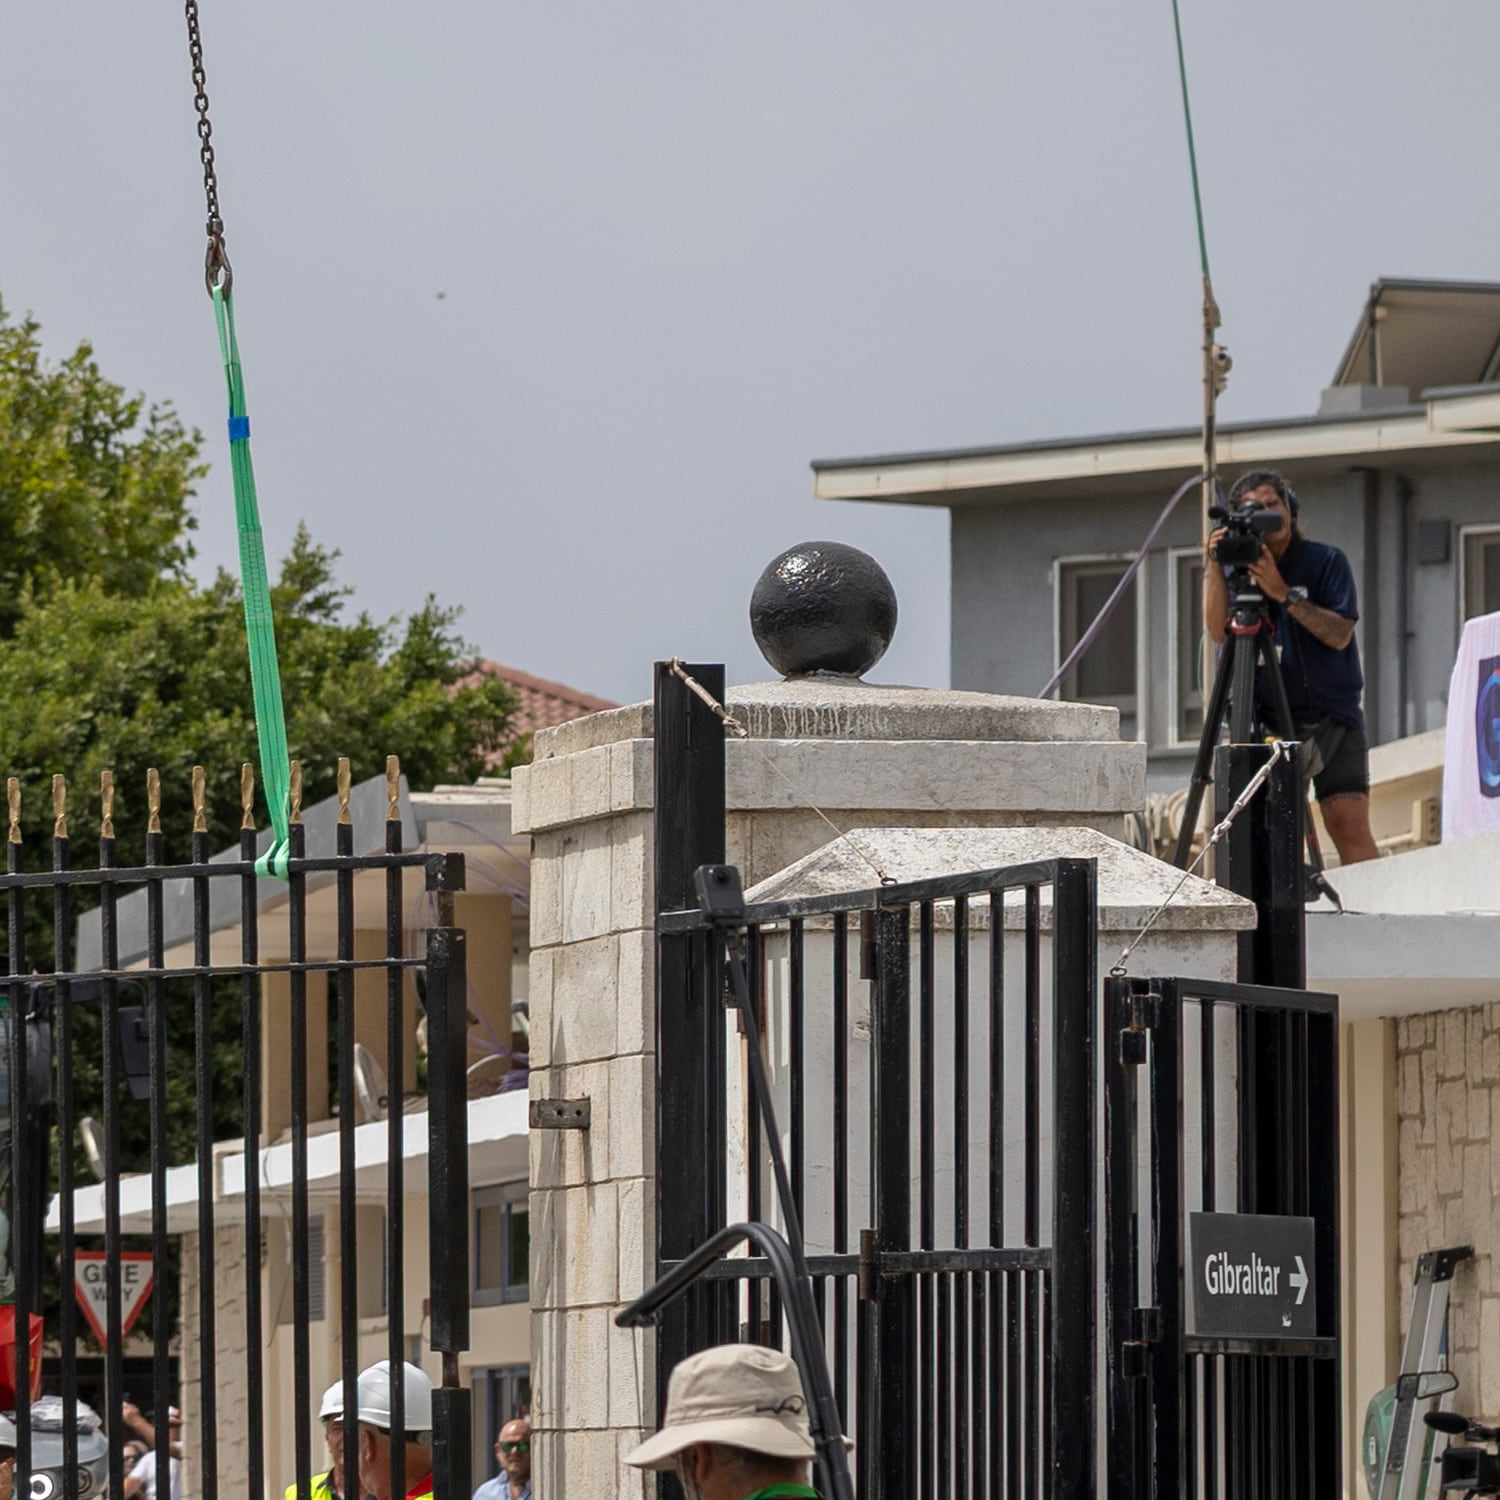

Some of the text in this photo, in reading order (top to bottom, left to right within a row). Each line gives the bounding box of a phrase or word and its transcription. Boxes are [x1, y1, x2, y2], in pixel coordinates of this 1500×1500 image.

[83, 1264, 139, 1284] GIE
[1205, 1251, 1280, 1295] Gibraltar
[92, 1287, 134, 1301] WY
